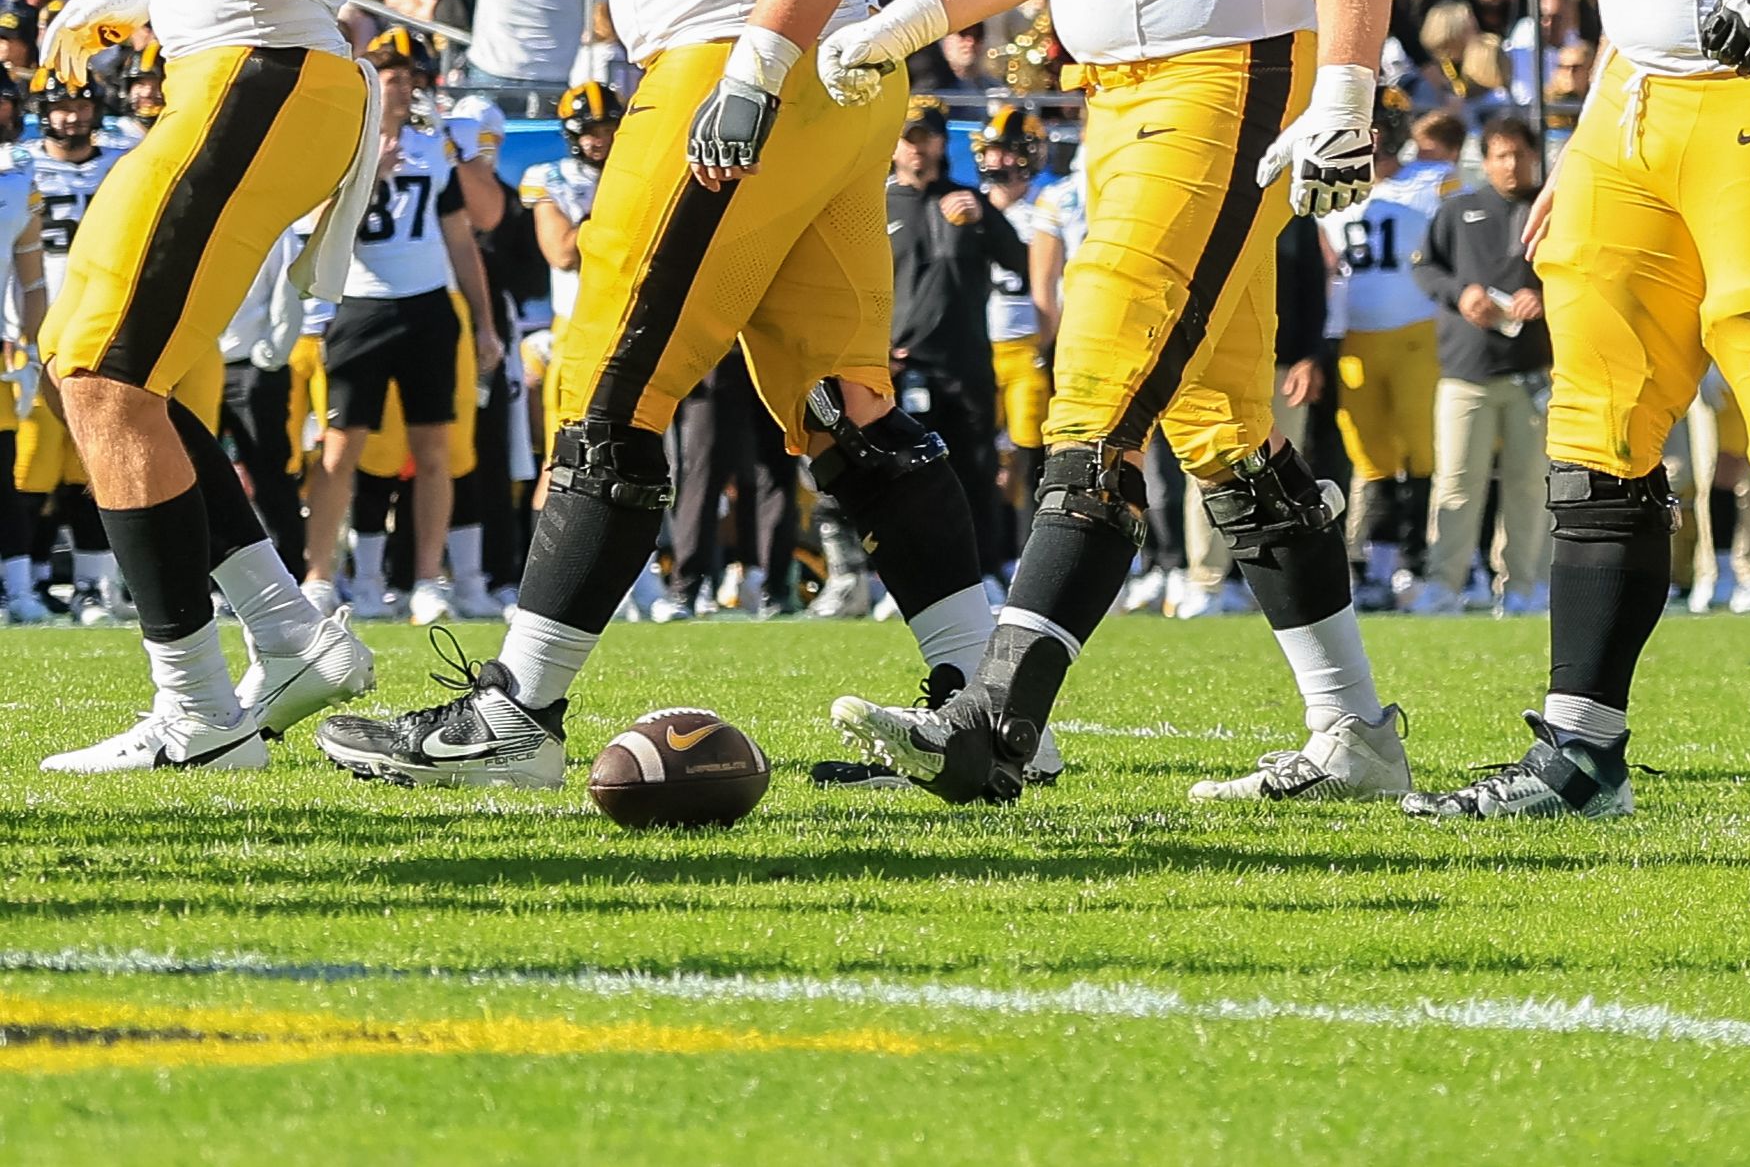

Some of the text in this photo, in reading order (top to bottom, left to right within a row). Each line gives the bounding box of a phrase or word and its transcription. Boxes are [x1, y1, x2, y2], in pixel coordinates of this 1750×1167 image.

[41, 193, 97, 254] 5
[357, 175, 431, 242] 87
[483, 751, 536, 767] FORCE
